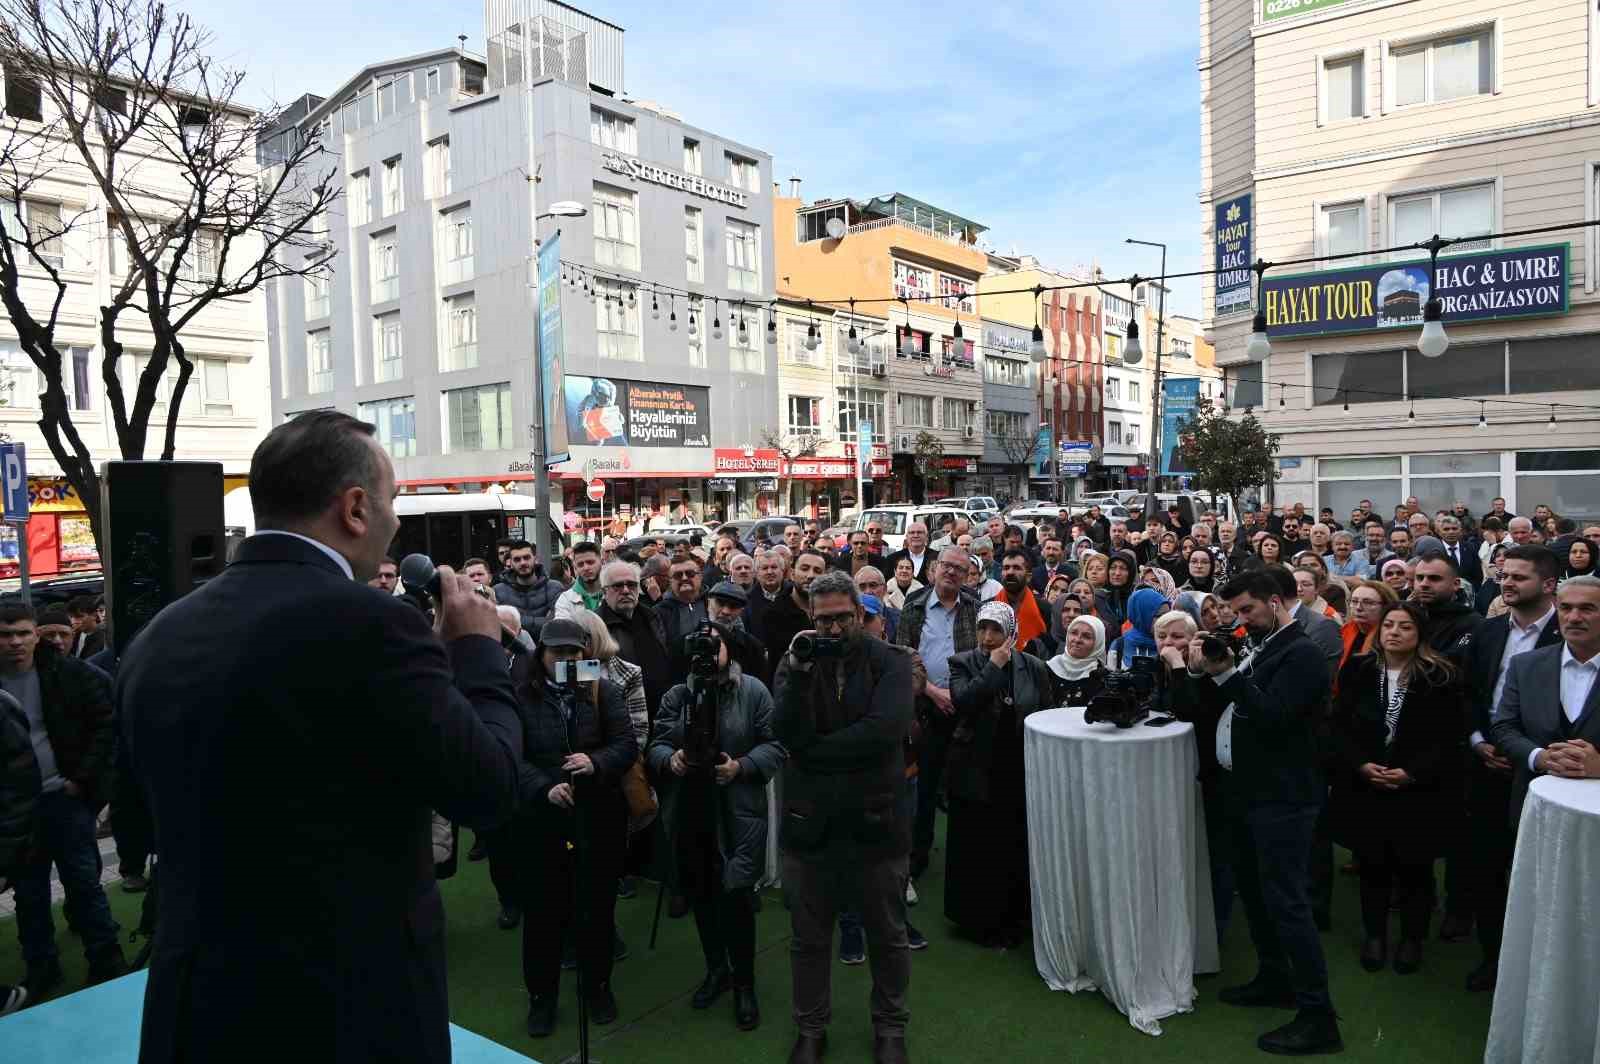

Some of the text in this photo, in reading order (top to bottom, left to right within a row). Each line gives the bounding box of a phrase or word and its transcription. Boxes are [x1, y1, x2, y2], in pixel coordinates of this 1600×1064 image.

[1217, 221, 1249, 245] HAYAT
[1226, 240, 1241, 252] tour
[1222, 252, 1246, 269] HAC
[1218, 269, 1250, 289] UMRE
[1435, 255, 1560, 290] HAC & UMRE
[1265, 286, 1321, 326] HAYAT
[1323, 280, 1374, 321] TOUR
[1436, 285, 1560, 314] ORGANİZASYON
[630, 409, 697, 427] Hayallerinizi
[630, 423, 677, 442] Büyütün
[6, 454, 21, 511] P
